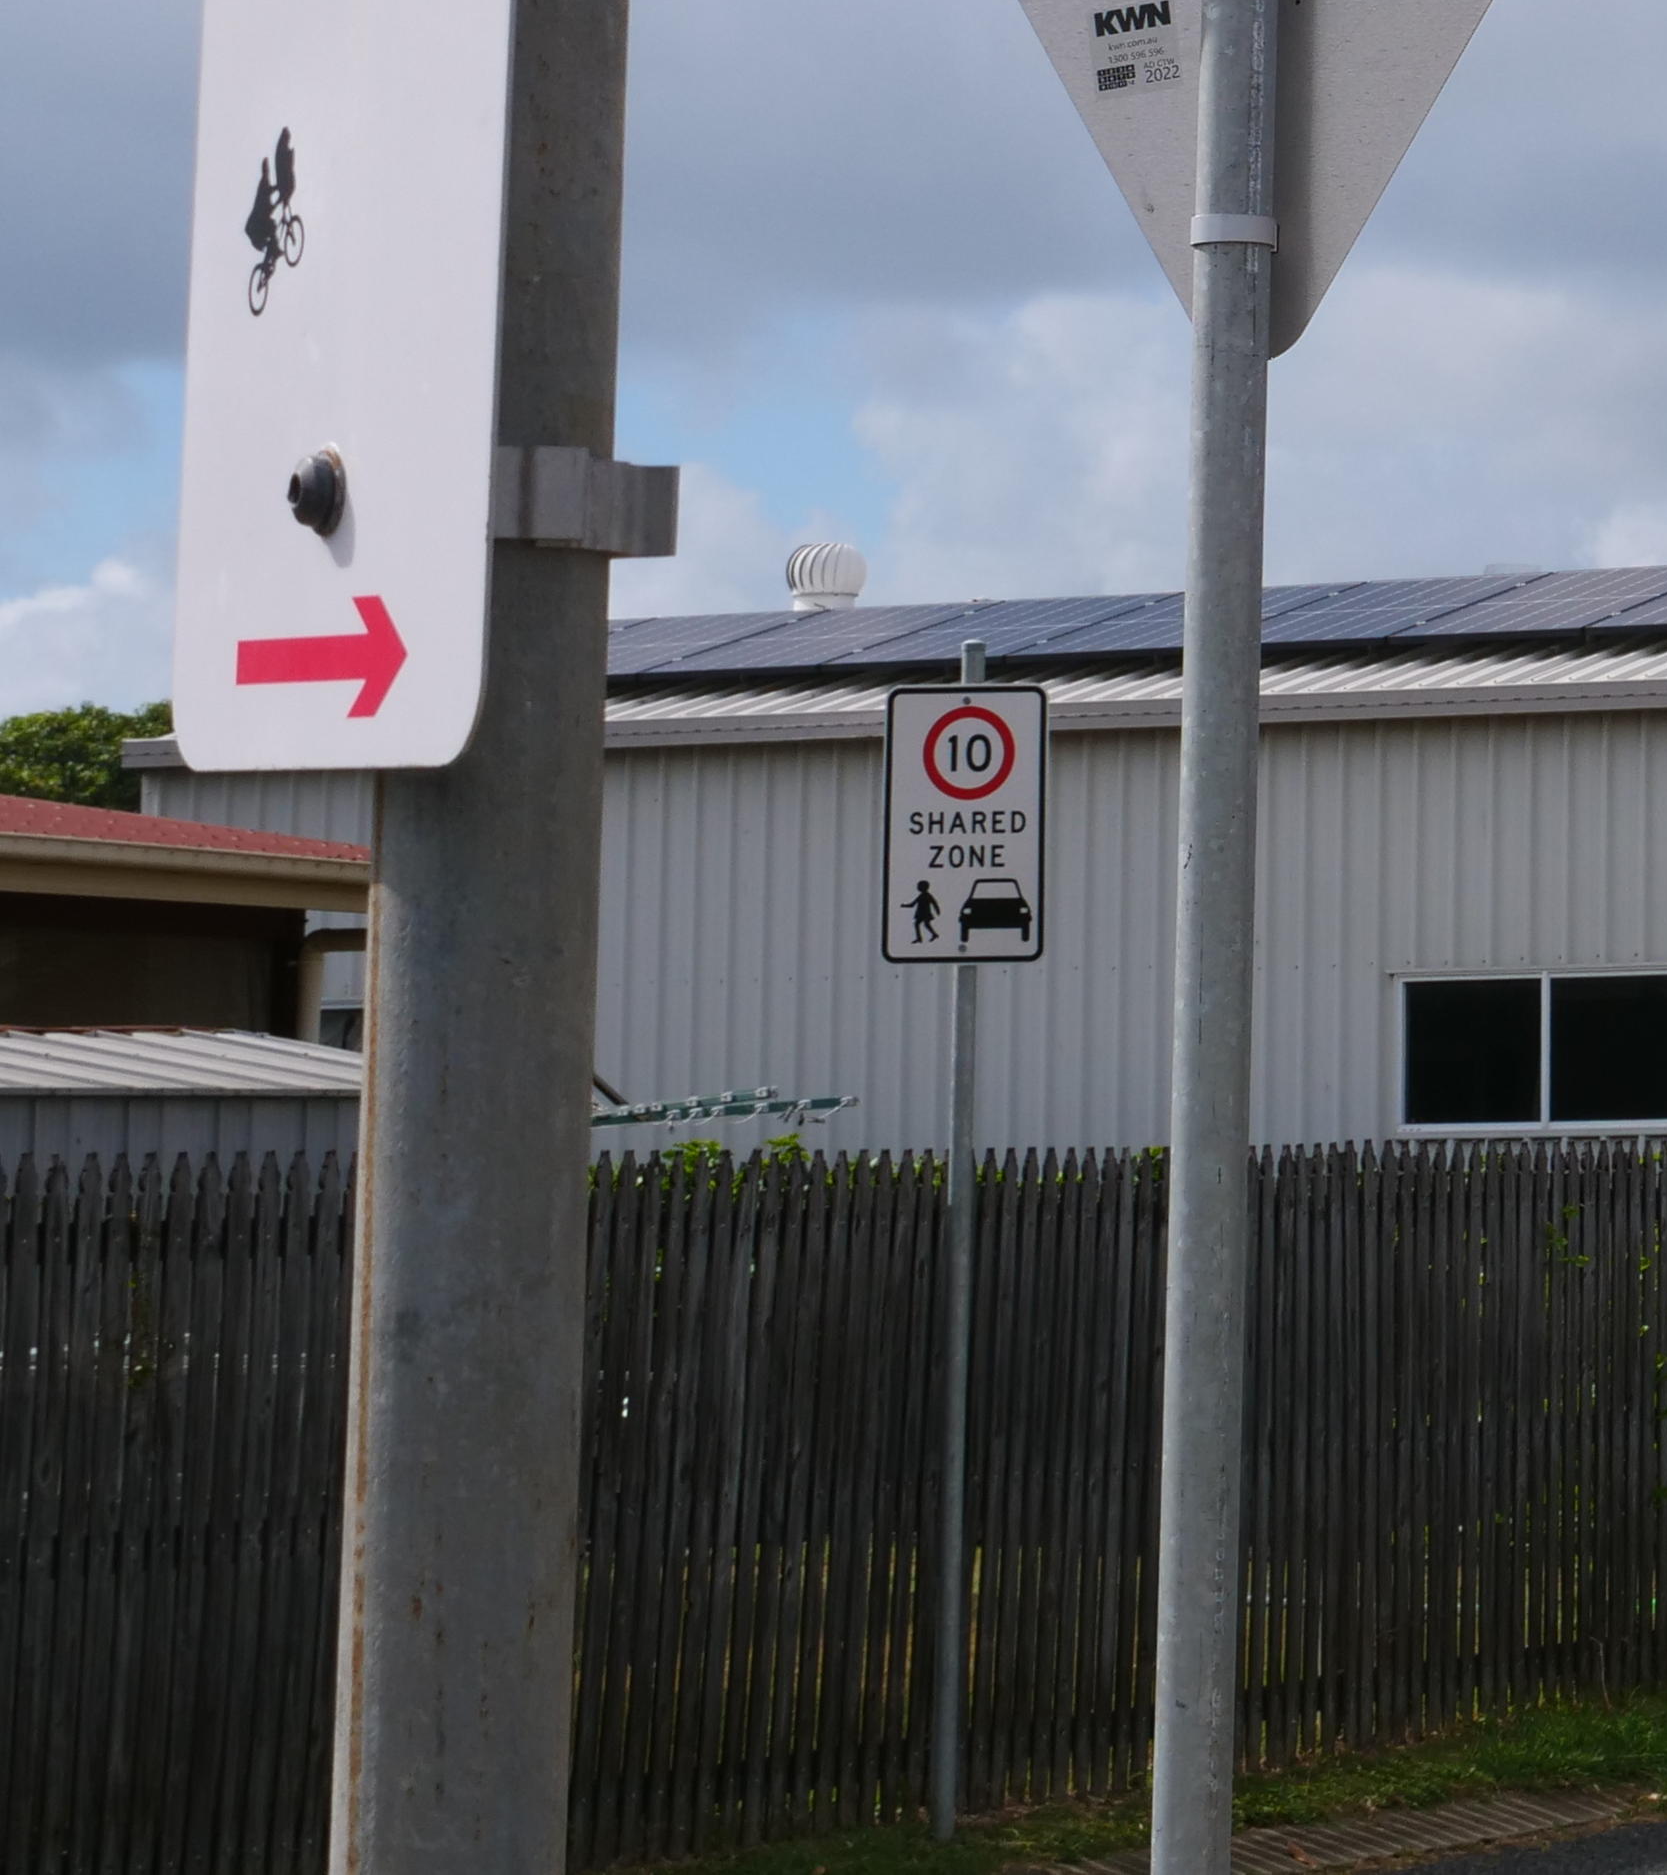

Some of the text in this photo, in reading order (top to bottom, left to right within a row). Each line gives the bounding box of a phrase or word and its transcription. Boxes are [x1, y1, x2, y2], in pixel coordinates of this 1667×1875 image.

[1093, 0, 1171, 37] KWN
[1145, 64, 1180, 83] 2022
[948, 734, 992, 772] 10
[909, 810, 1026, 835] SHARED
[928, 844, 1006, 868] ZONE
